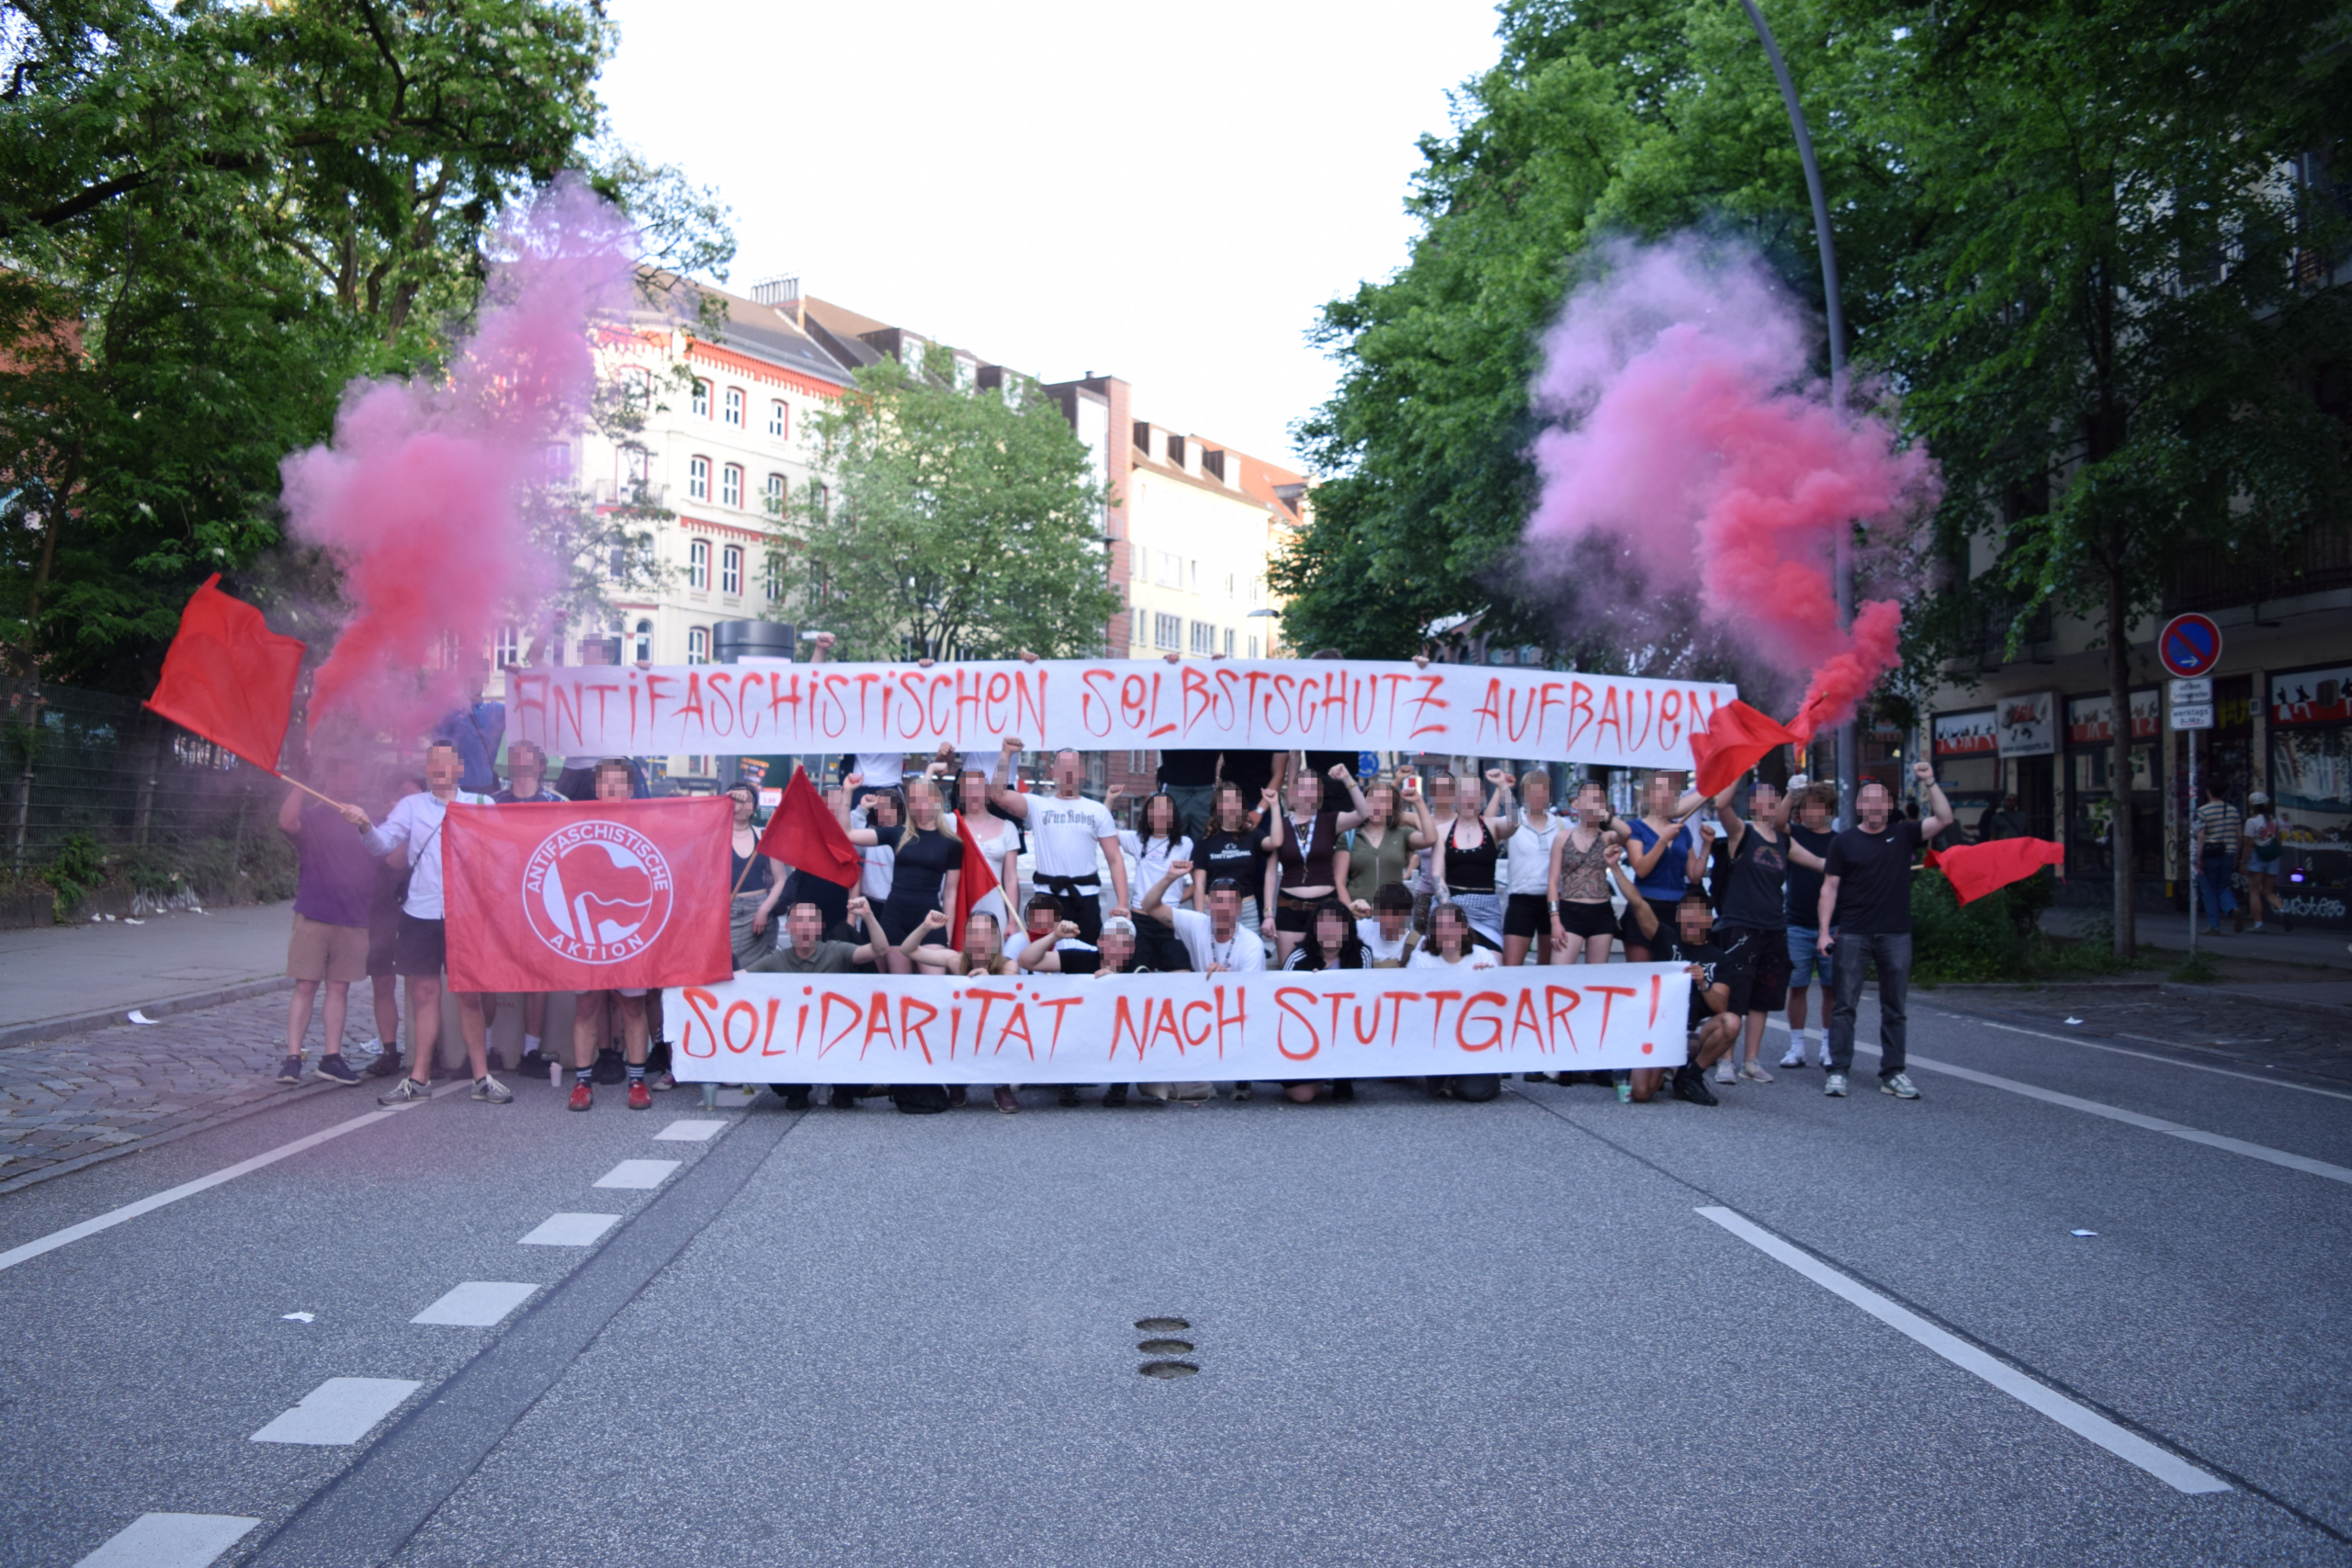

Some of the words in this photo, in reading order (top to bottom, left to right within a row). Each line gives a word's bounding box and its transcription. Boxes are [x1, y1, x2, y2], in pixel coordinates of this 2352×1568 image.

[2173, 708, 2209, 716] werktags
[527, 825, 669, 894] ANTIFASCHISTISCHE
[549, 933, 644, 960] AKTION
[1109, 986, 1247, 1061] NACH
